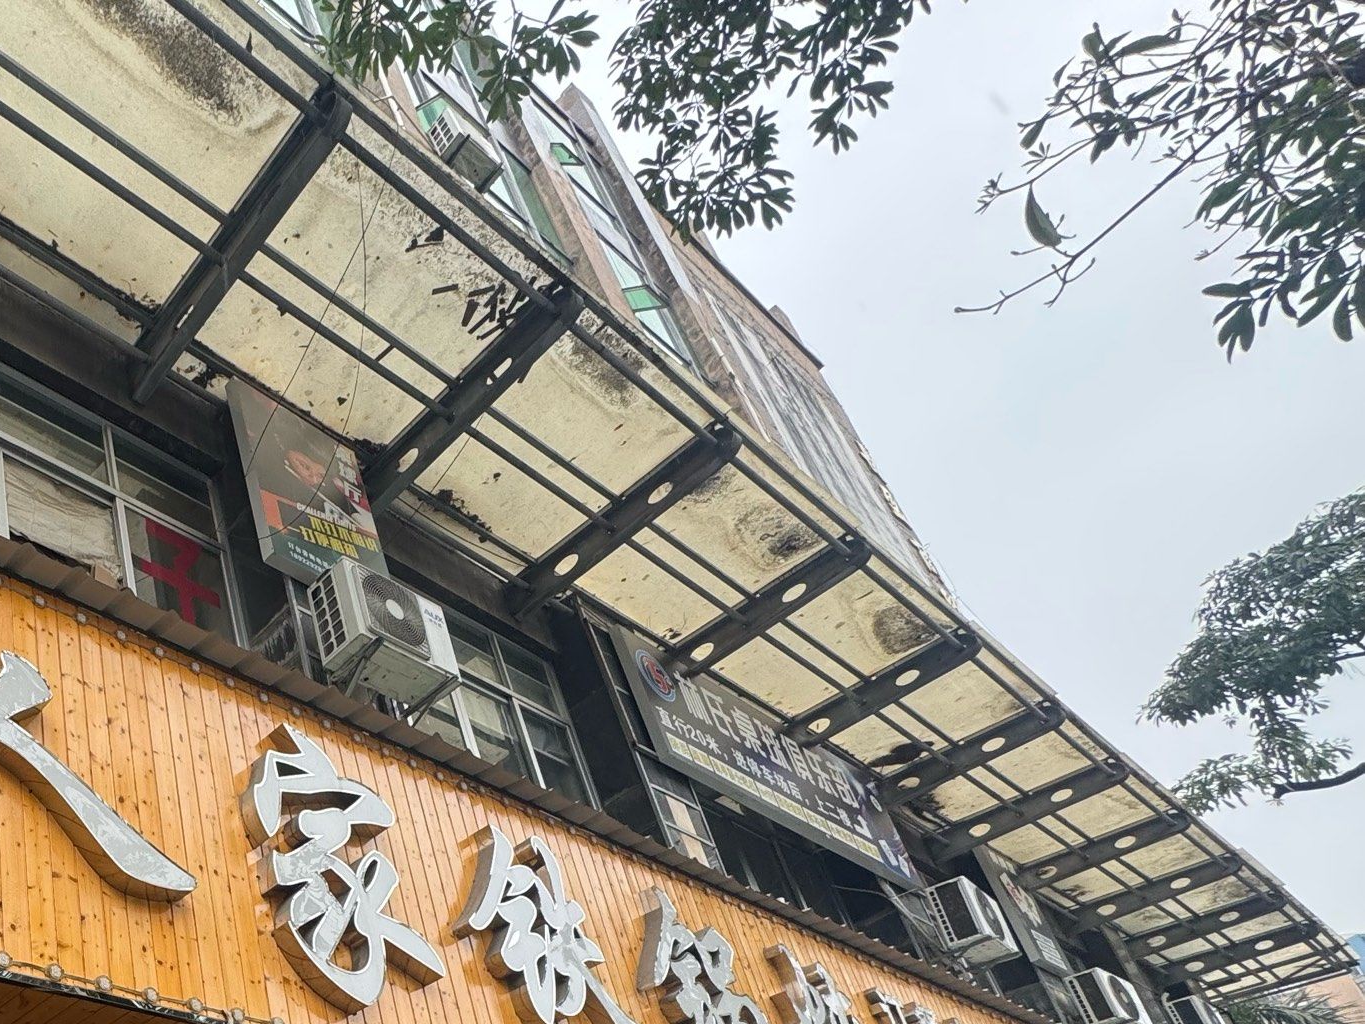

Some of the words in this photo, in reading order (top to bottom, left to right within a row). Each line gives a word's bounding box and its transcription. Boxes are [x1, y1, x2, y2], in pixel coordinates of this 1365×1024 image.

[672, 669, 860, 812] 林氏桌球俱乐部
